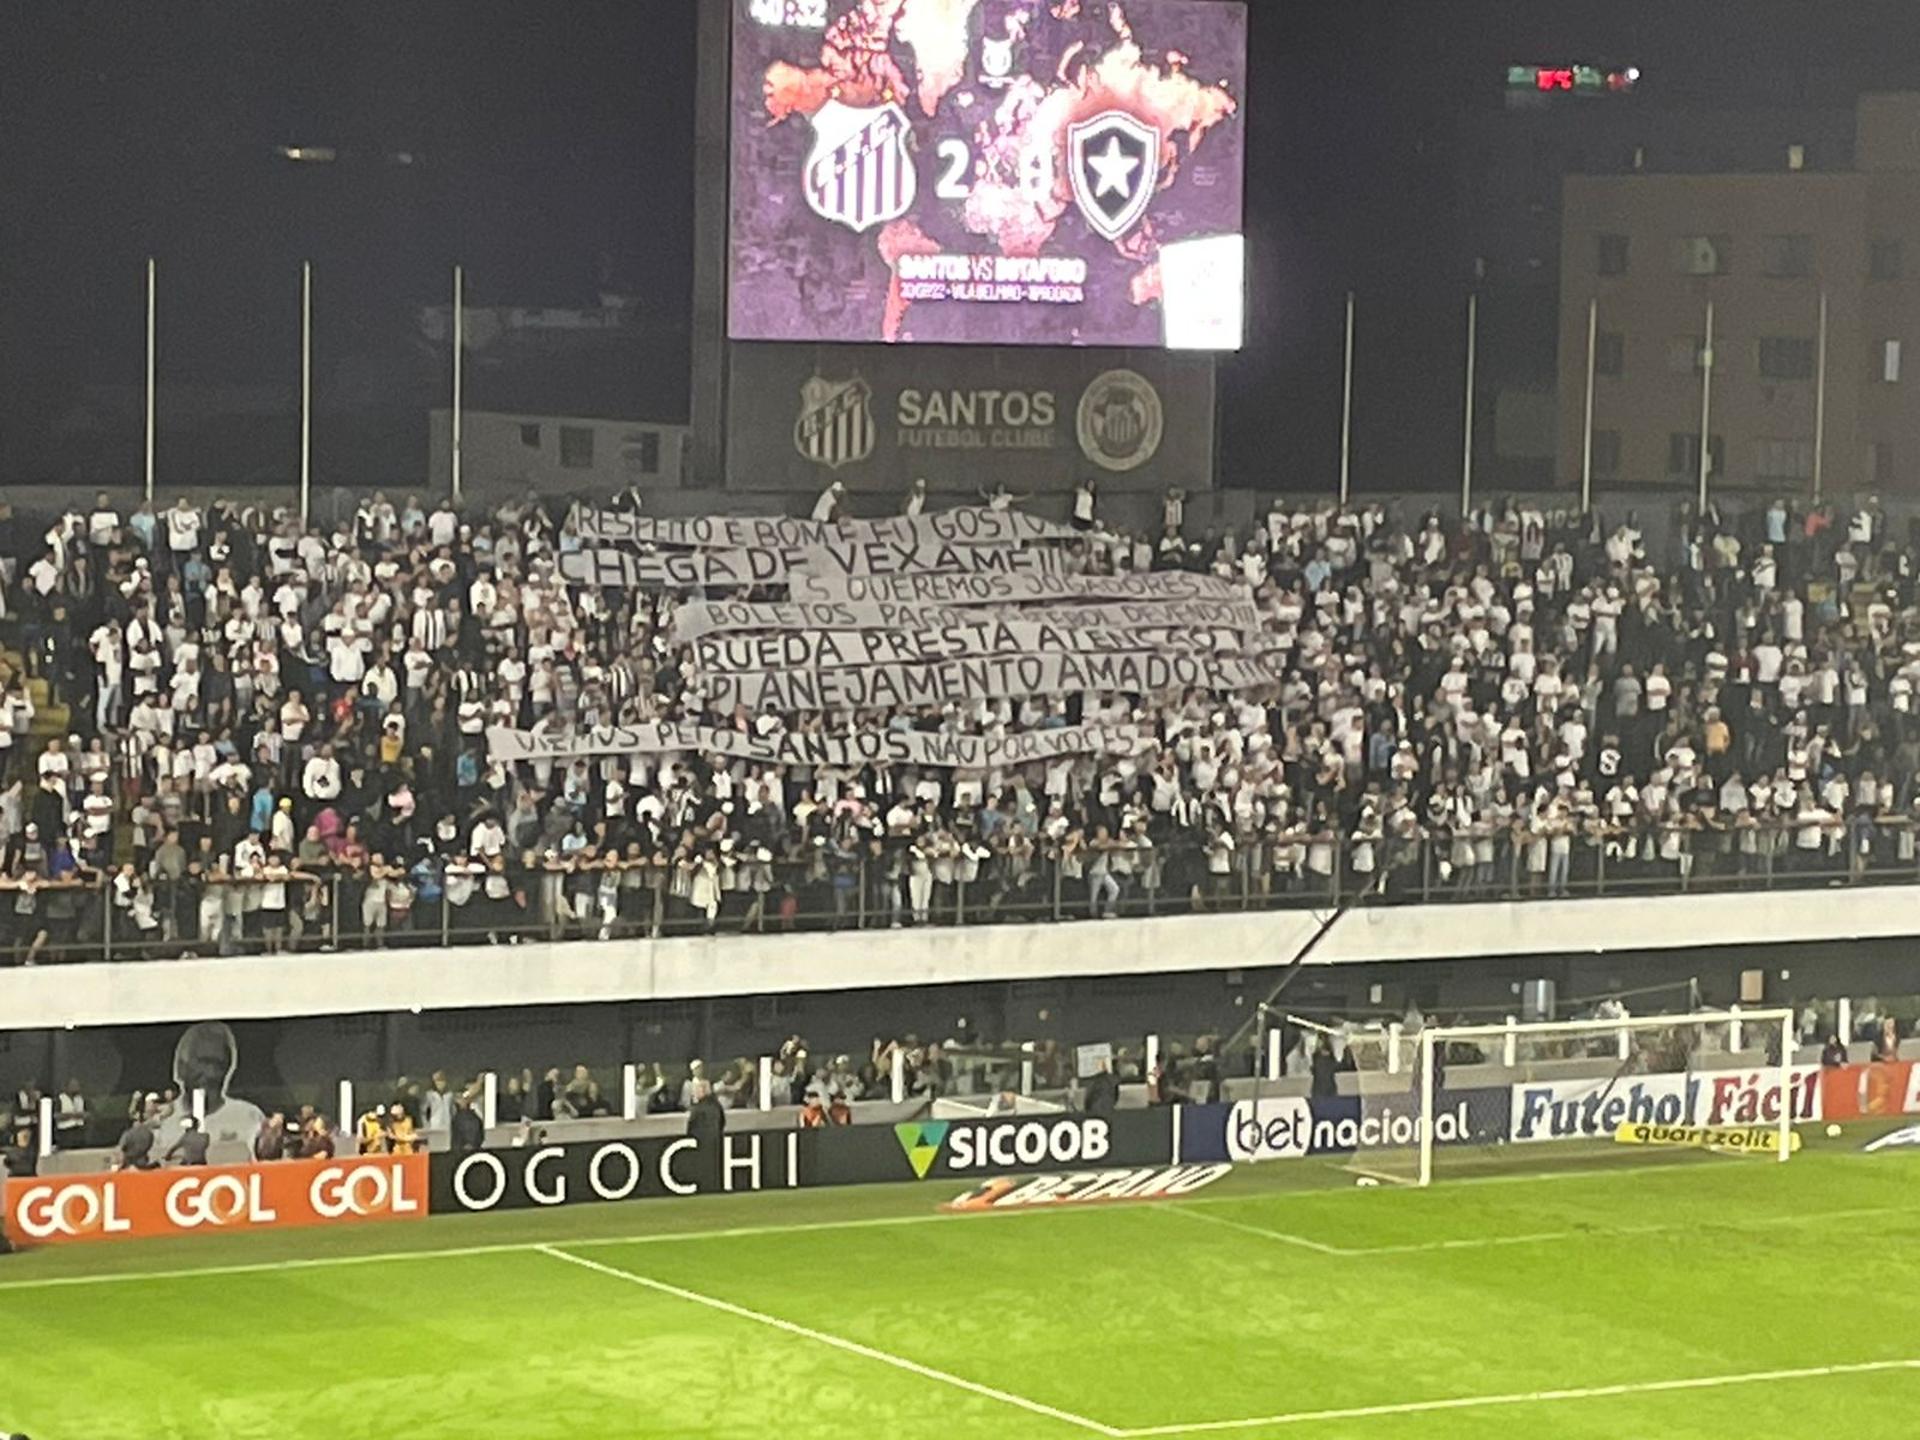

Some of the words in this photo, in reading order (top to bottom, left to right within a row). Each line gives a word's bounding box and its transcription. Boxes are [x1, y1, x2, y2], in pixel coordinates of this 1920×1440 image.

[935, 139, 971, 199] 2
[898, 389, 1055, 426] SANTOS
[898, 428, 985, 448] FUTEBOL
[991, 428, 1053, 448] CLUBE
[754, 516, 828, 548] BOM
[558, 549, 737, 586] CHEGA
[705, 602, 858, 626] BOLETOS
[700, 630, 845, 671] RUEDA
[861, 619, 1022, 662] PRESTA
[984, 733, 1040, 768] POR
[1516, 1079, 1700, 1141] Futebol
[1707, 1071, 1820, 1126] Fácil
[948, 1118, 1110, 1170] SICOOB
[1633, 1124, 1772, 1149] quartzolit
[453, 1132, 798, 1211] OGOCHI
[16, 1182, 131, 1238] GOL
[165, 1173, 277, 1227] GOL
[310, 1164, 418, 1217] GOL
